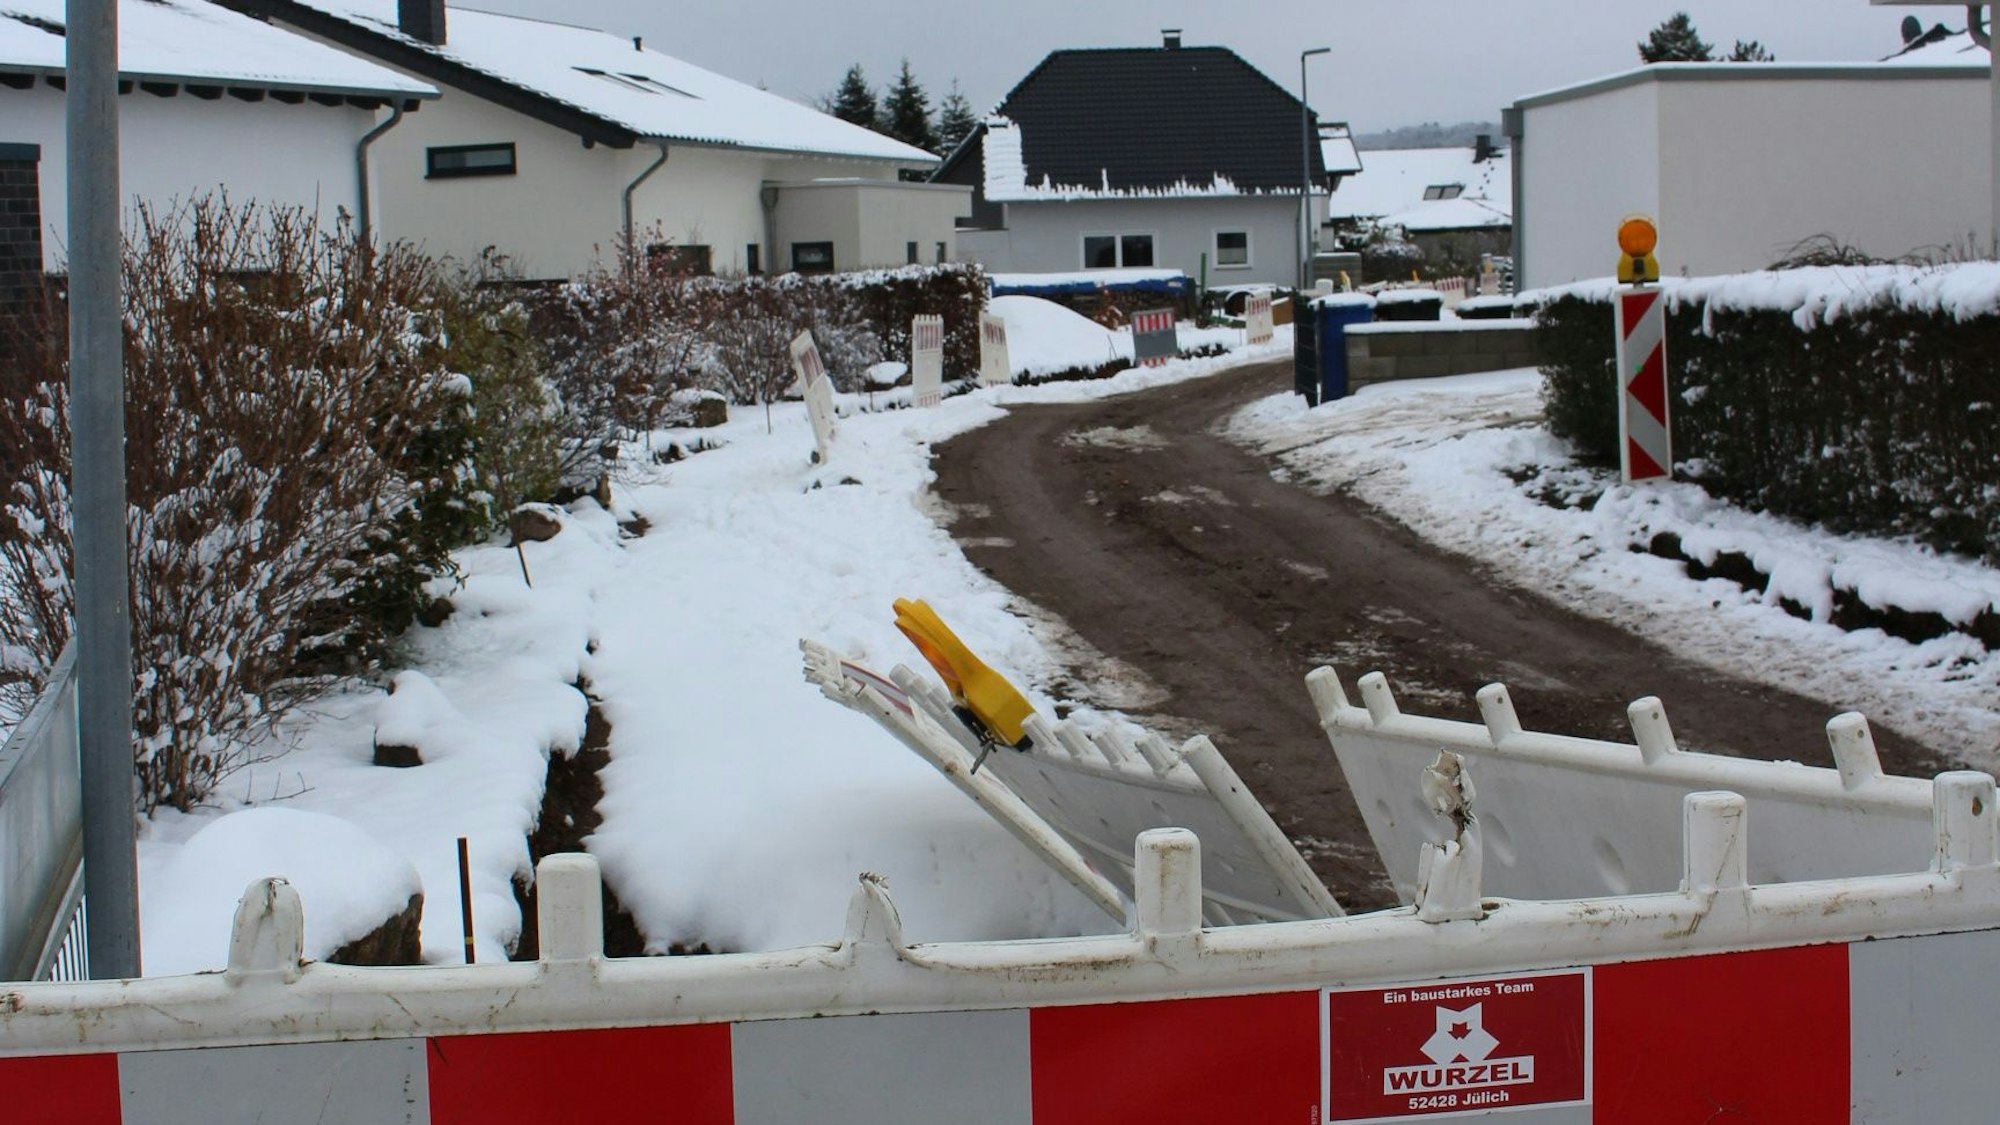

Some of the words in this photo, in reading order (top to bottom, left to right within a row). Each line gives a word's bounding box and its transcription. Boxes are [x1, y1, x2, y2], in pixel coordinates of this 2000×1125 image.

[1384, 992, 1407, 1003] Ein
[1411, 987, 1491, 1001] baustarkes
[1495, 983, 1534, 995] Team
[1388, 1062, 1529, 1090] WURZEL
[1408, 1096, 1457, 1109] 52428
[1462, 1091, 1509, 1105] Jülich
